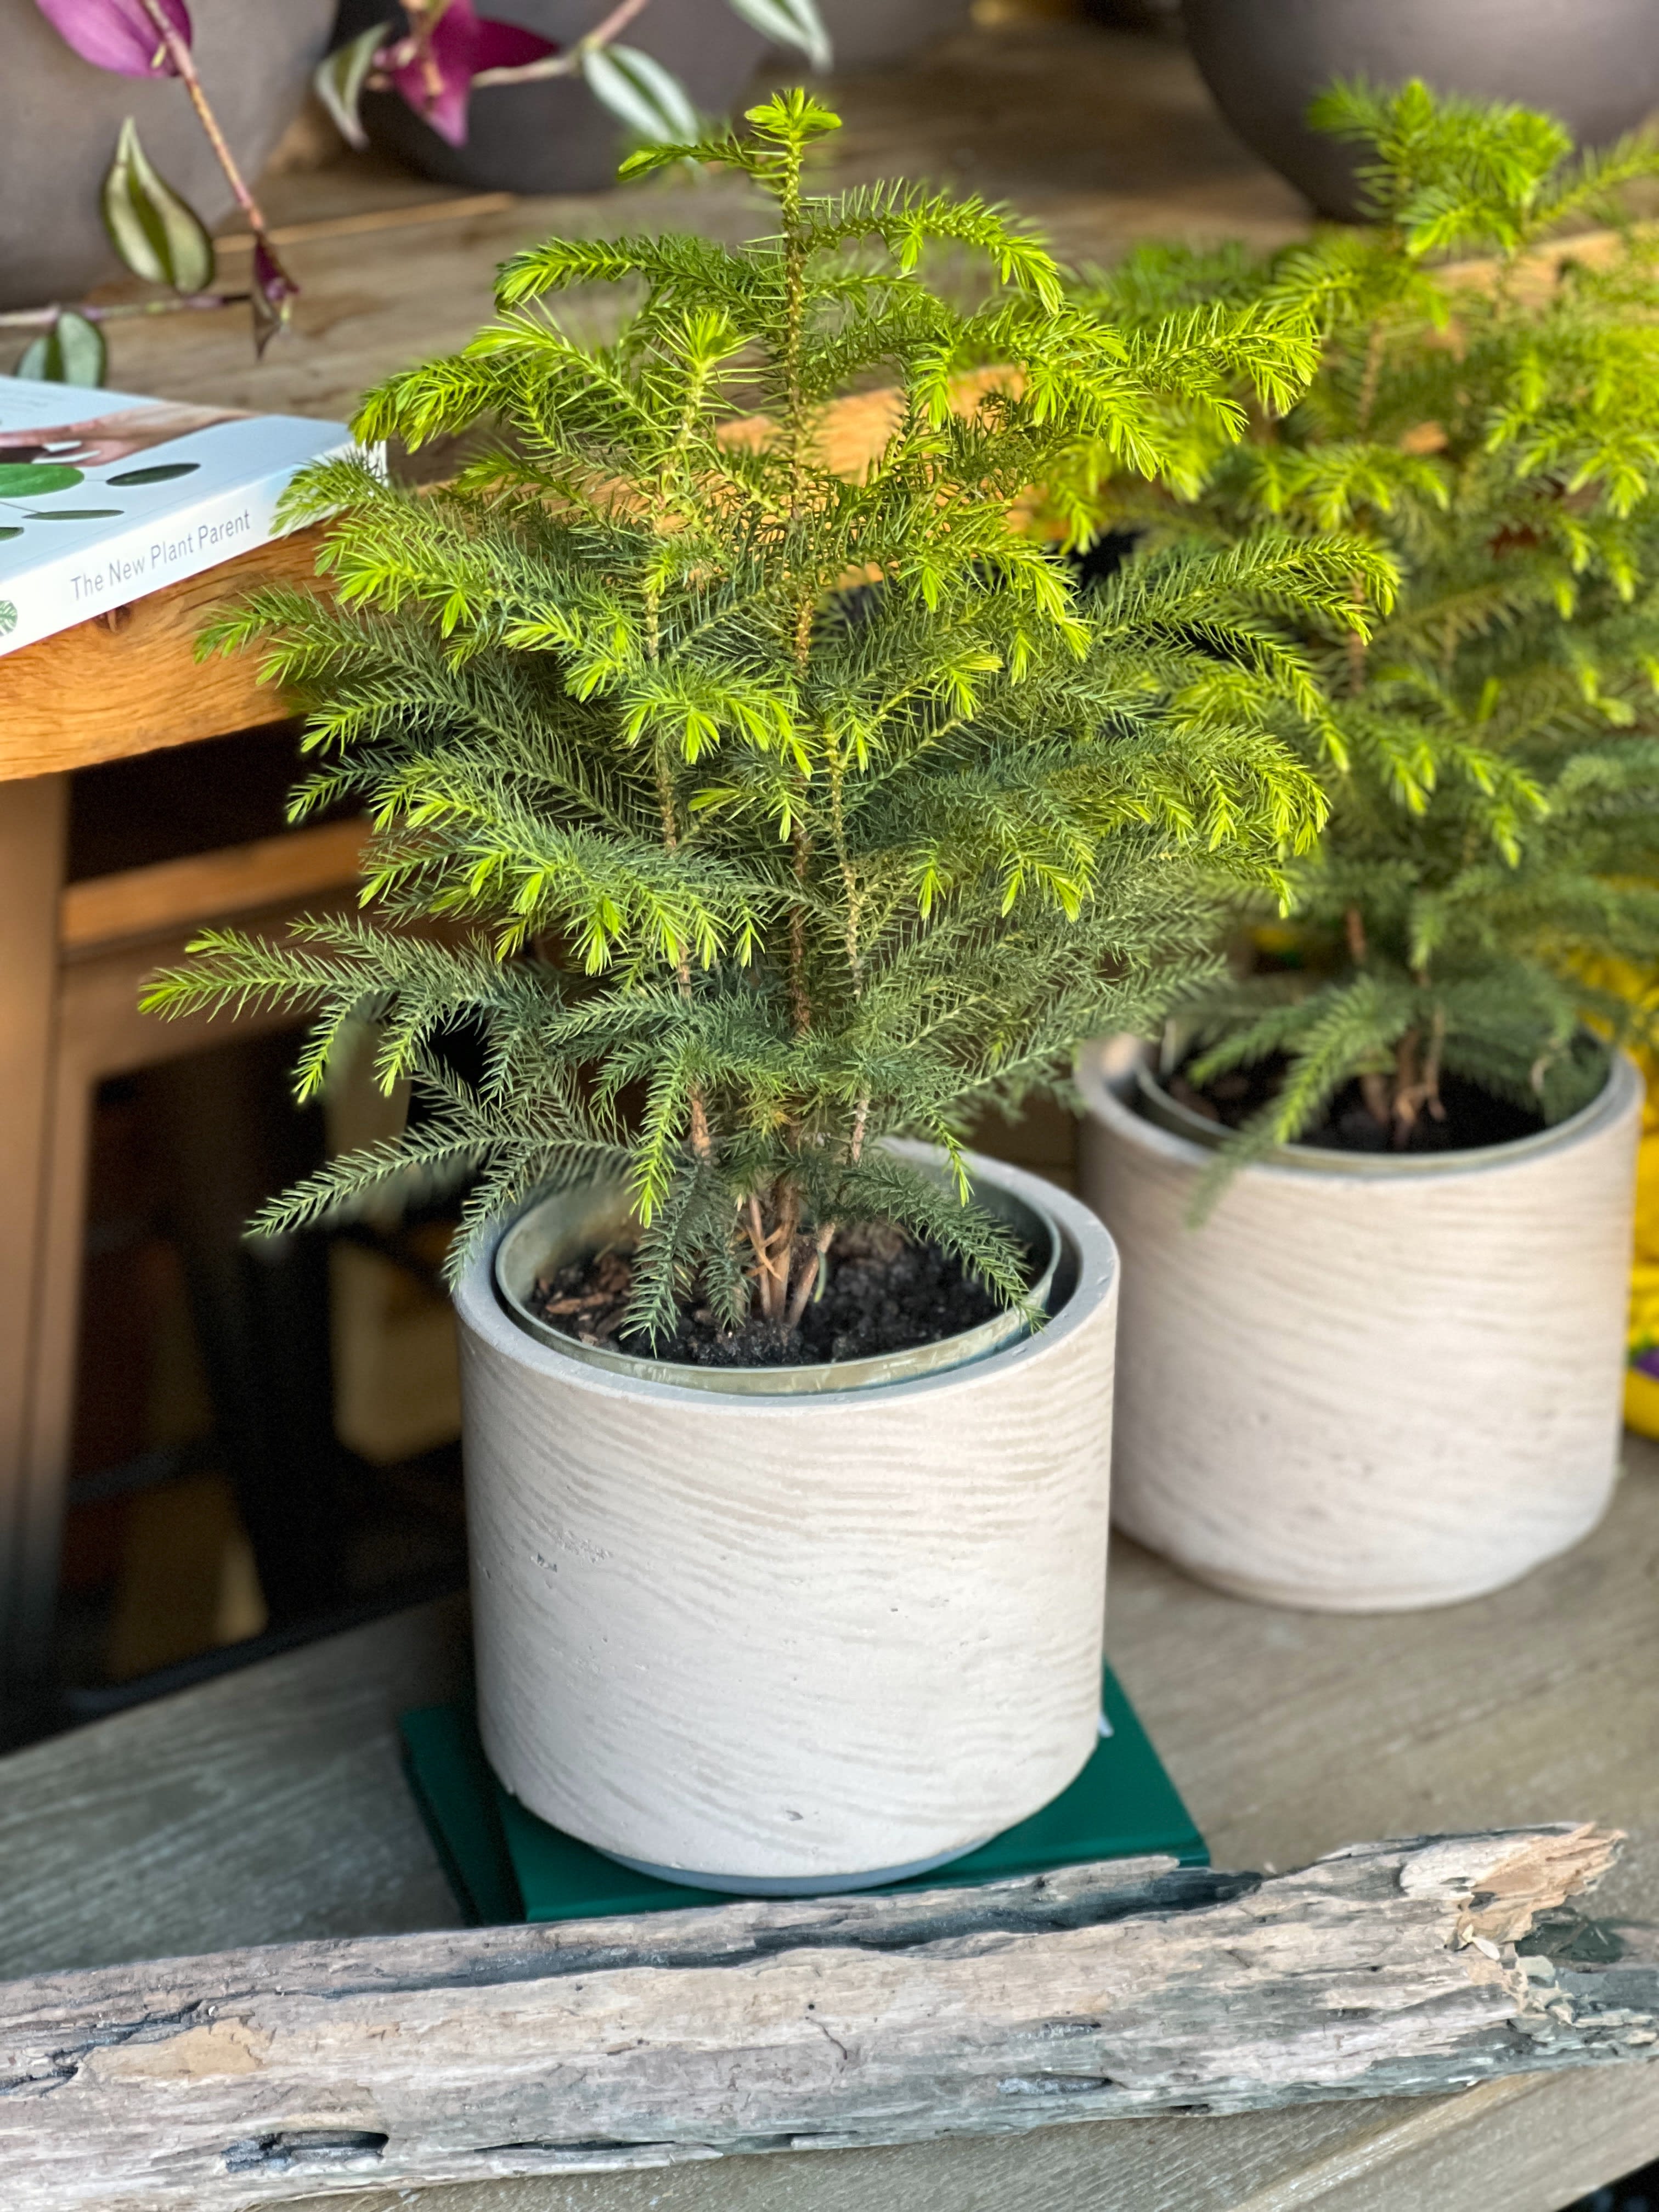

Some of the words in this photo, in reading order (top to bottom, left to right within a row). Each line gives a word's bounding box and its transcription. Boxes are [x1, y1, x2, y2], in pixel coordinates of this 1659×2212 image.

[70, 573, 104, 600] The
[109, 555, 145, 586] New
[150, 533, 194, 569] Plant
[198, 509, 250, 549] Parent
